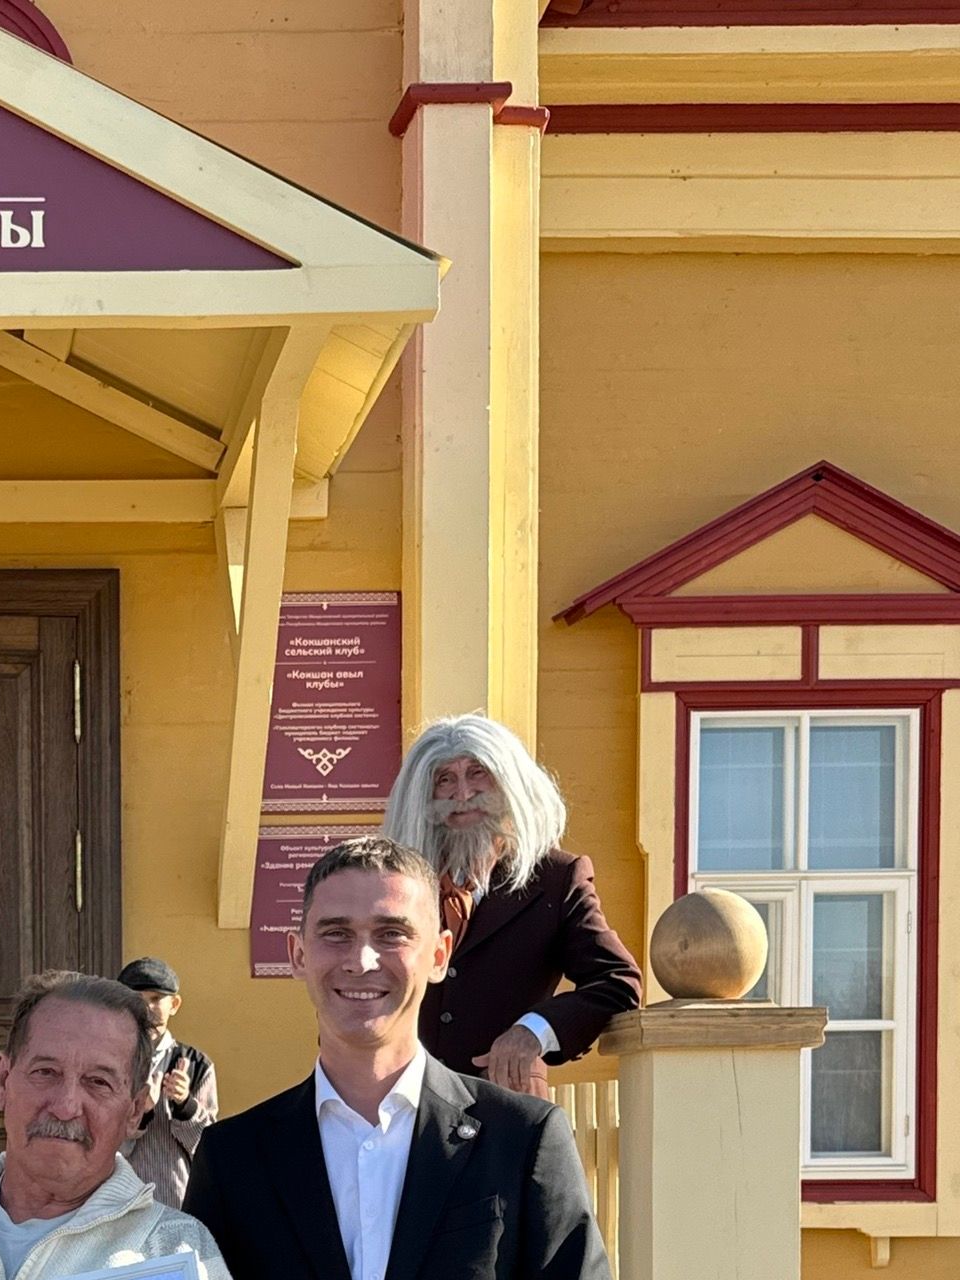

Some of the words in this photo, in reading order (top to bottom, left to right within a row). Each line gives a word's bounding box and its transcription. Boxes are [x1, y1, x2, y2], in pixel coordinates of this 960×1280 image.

[289, 636, 361, 647] «Кокшанский
[284, 647, 332, 657] сельский
[336, 670, 364, 679] авыл
[305, 680, 345, 691] клубы»
